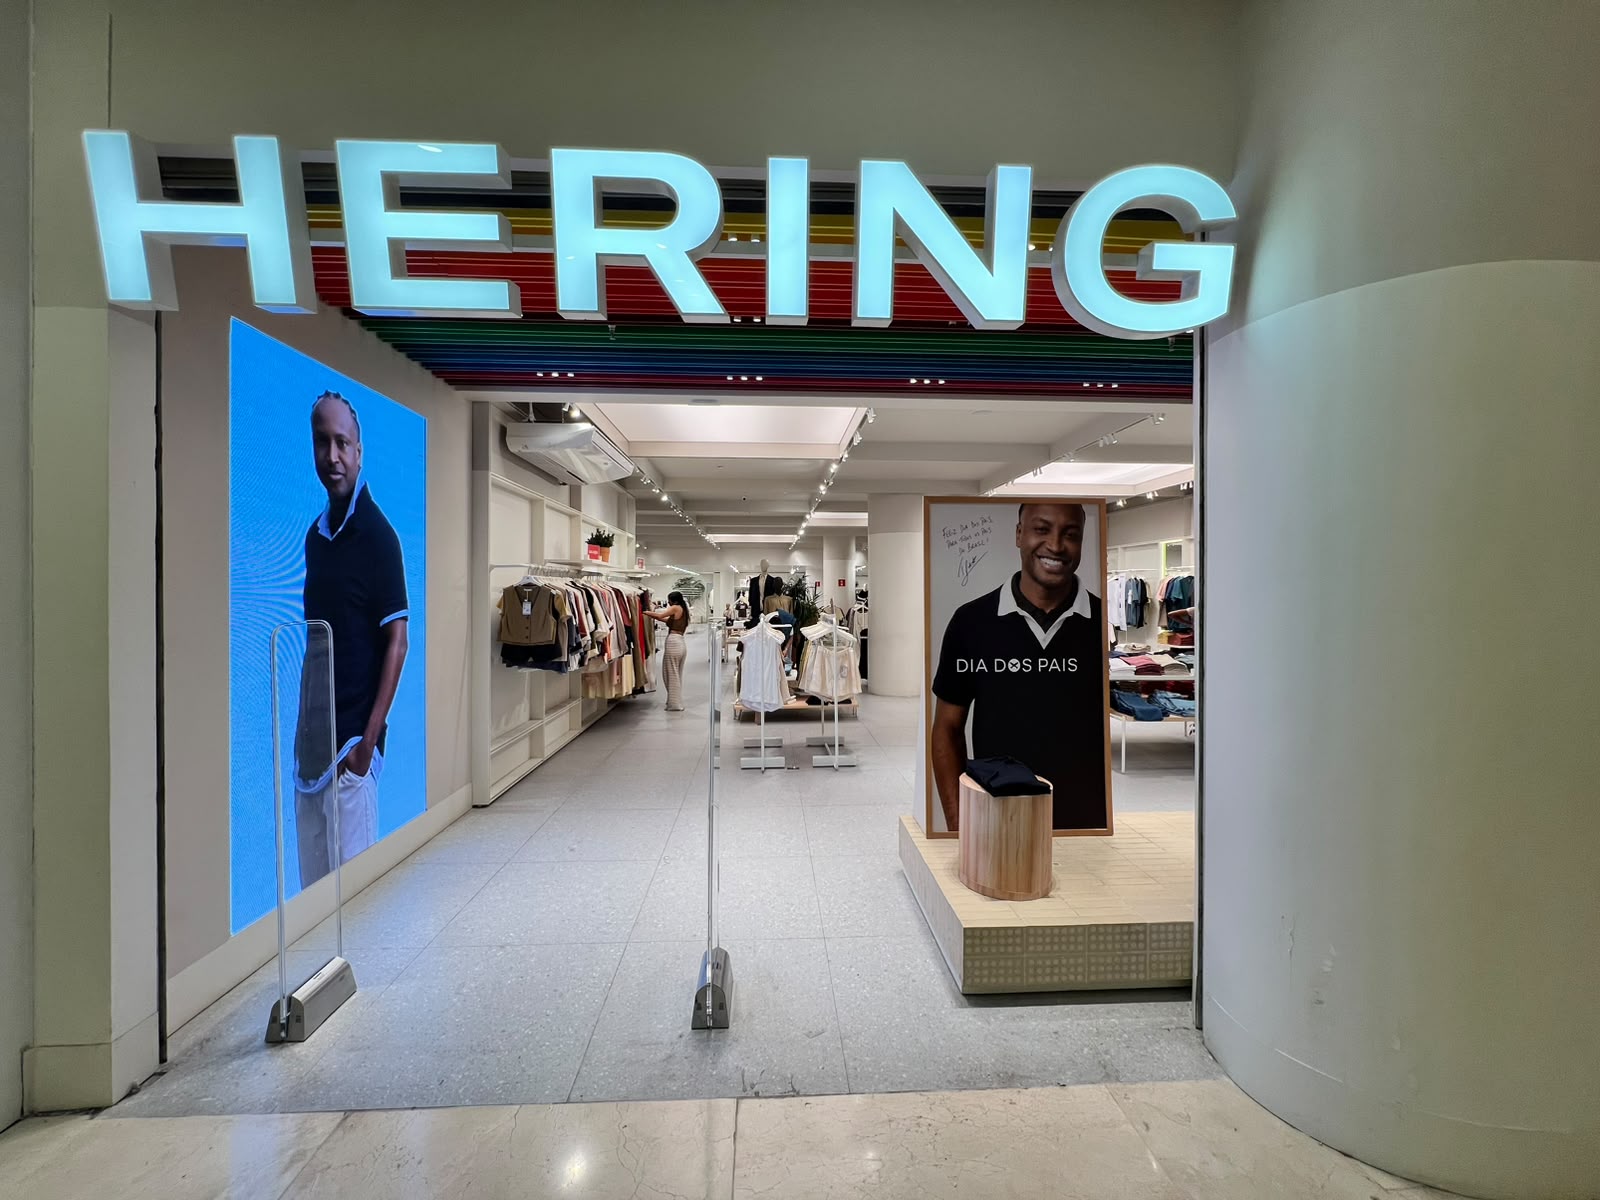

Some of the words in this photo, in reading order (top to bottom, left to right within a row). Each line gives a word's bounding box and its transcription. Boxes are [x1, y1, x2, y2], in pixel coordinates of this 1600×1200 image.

[82, 129, 1238, 336] HERING
[956, 658, 988, 673] DIA
[994, 658, 1032, 673] DOS
[1038, 658, 1078, 673] PAIS
